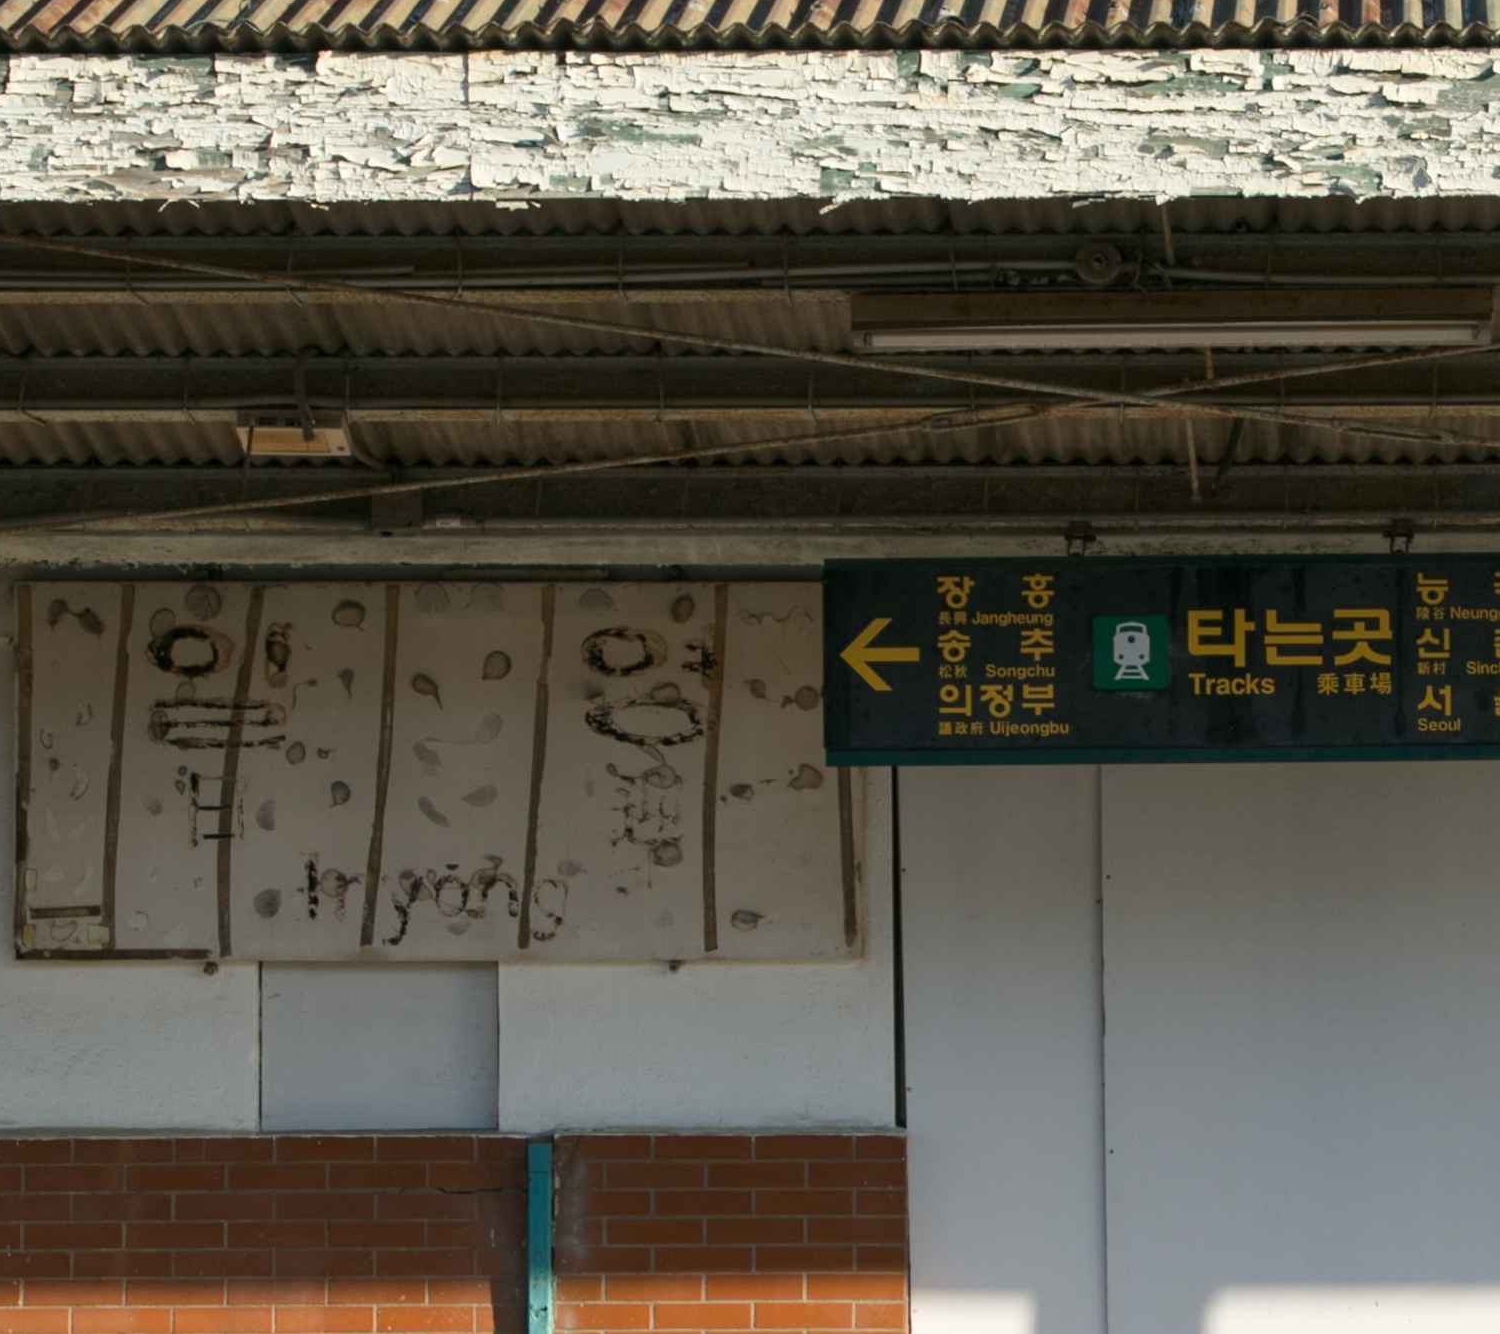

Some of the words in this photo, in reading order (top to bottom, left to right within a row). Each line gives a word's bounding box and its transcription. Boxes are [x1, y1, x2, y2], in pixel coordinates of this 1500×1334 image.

[972, 611, 1054, 626] Jangheung
[1187, 608, 1393, 667] 타는곳
[985, 664, 1055, 679] Songchu
[1188, 673, 1276, 695] Tracks
[939, 683, 1055, 717] 의정부
[990, 721, 1069, 736] Uijeongbu
[1418, 718, 1461, 731] Seoul
